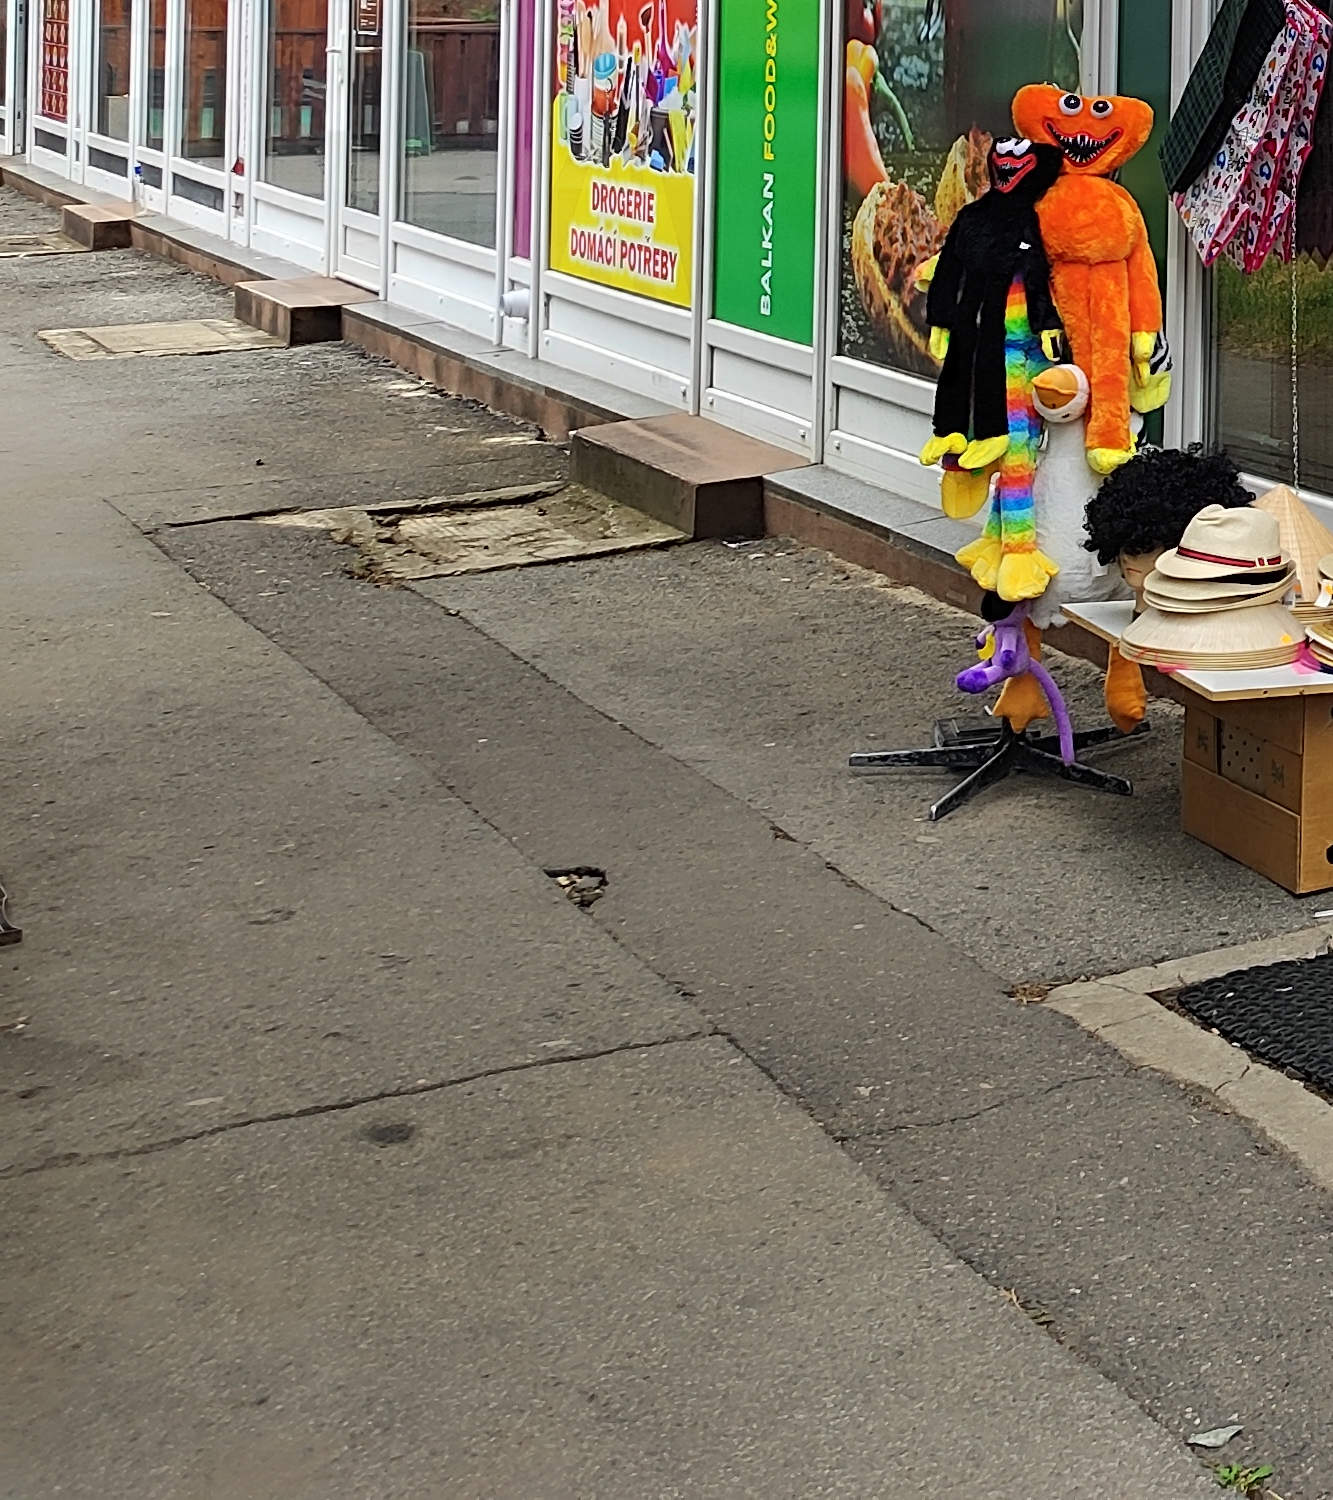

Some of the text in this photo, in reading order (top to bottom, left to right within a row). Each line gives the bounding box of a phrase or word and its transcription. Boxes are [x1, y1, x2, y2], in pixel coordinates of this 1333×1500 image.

[592, 181, 655, 223] DROGERIE
[570, 227, 678, 283] DOMÁCÍ POTŘEBY
[760, 173, 775, 316] BALKAN
